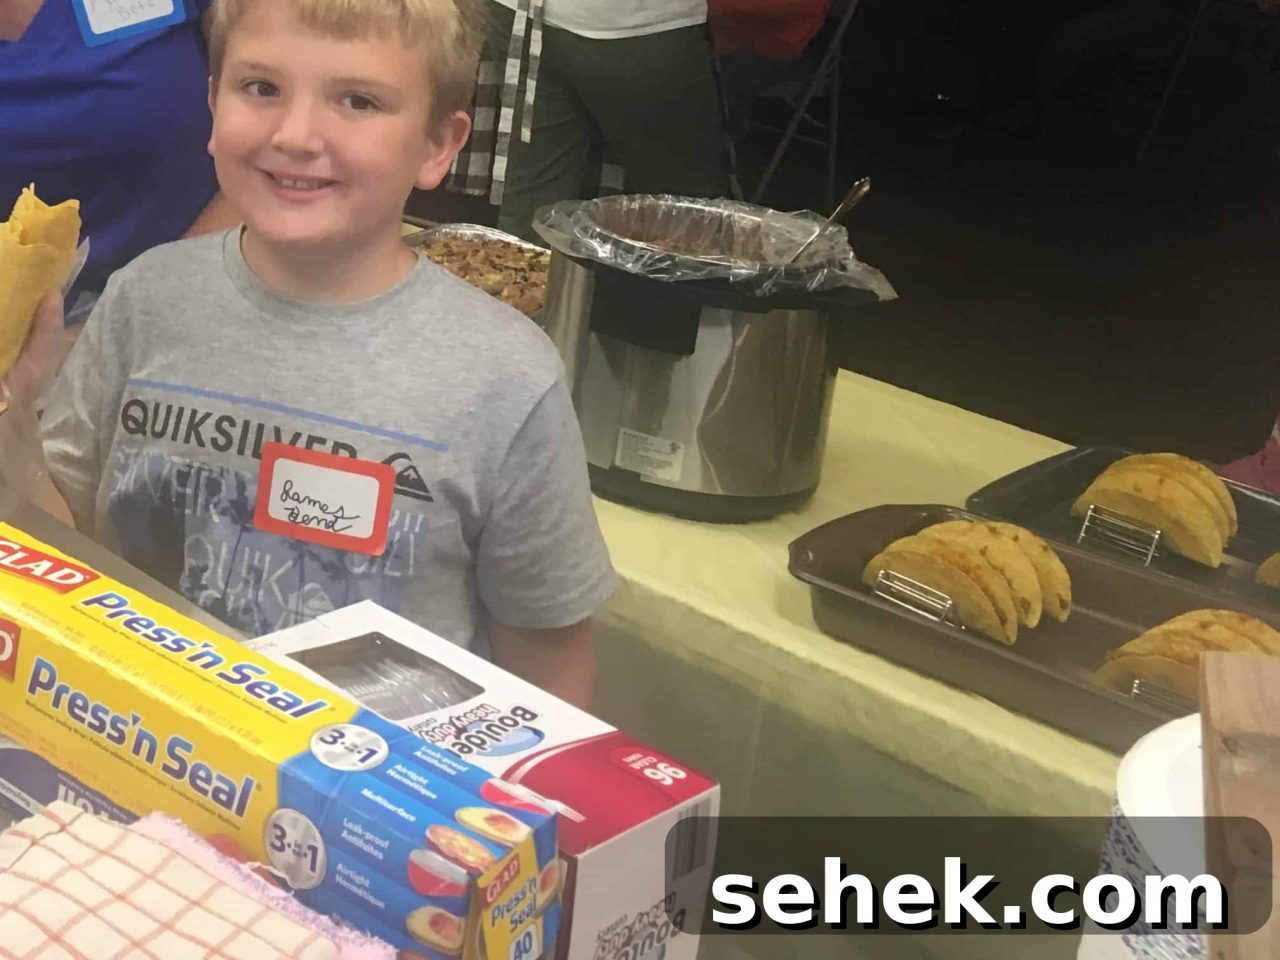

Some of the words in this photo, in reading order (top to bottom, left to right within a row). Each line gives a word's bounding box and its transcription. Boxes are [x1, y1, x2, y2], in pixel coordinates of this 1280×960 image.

[81, 592, 225, 669] Press'n
[216, 662, 328, 718] Seal
[28, 657, 159, 764] Press'n
[161, 736, 254, 818] Seal
[444, 705, 539, 758] Boulde
[643, 762, 688, 786] 96
[343, 817, 390, 849] Leak-proof
[336, 862, 370, 888] Airtight
[486, 859, 519, 903] GLAD
[509, 898, 537, 933] Seal
[513, 930, 533, 960] 40
